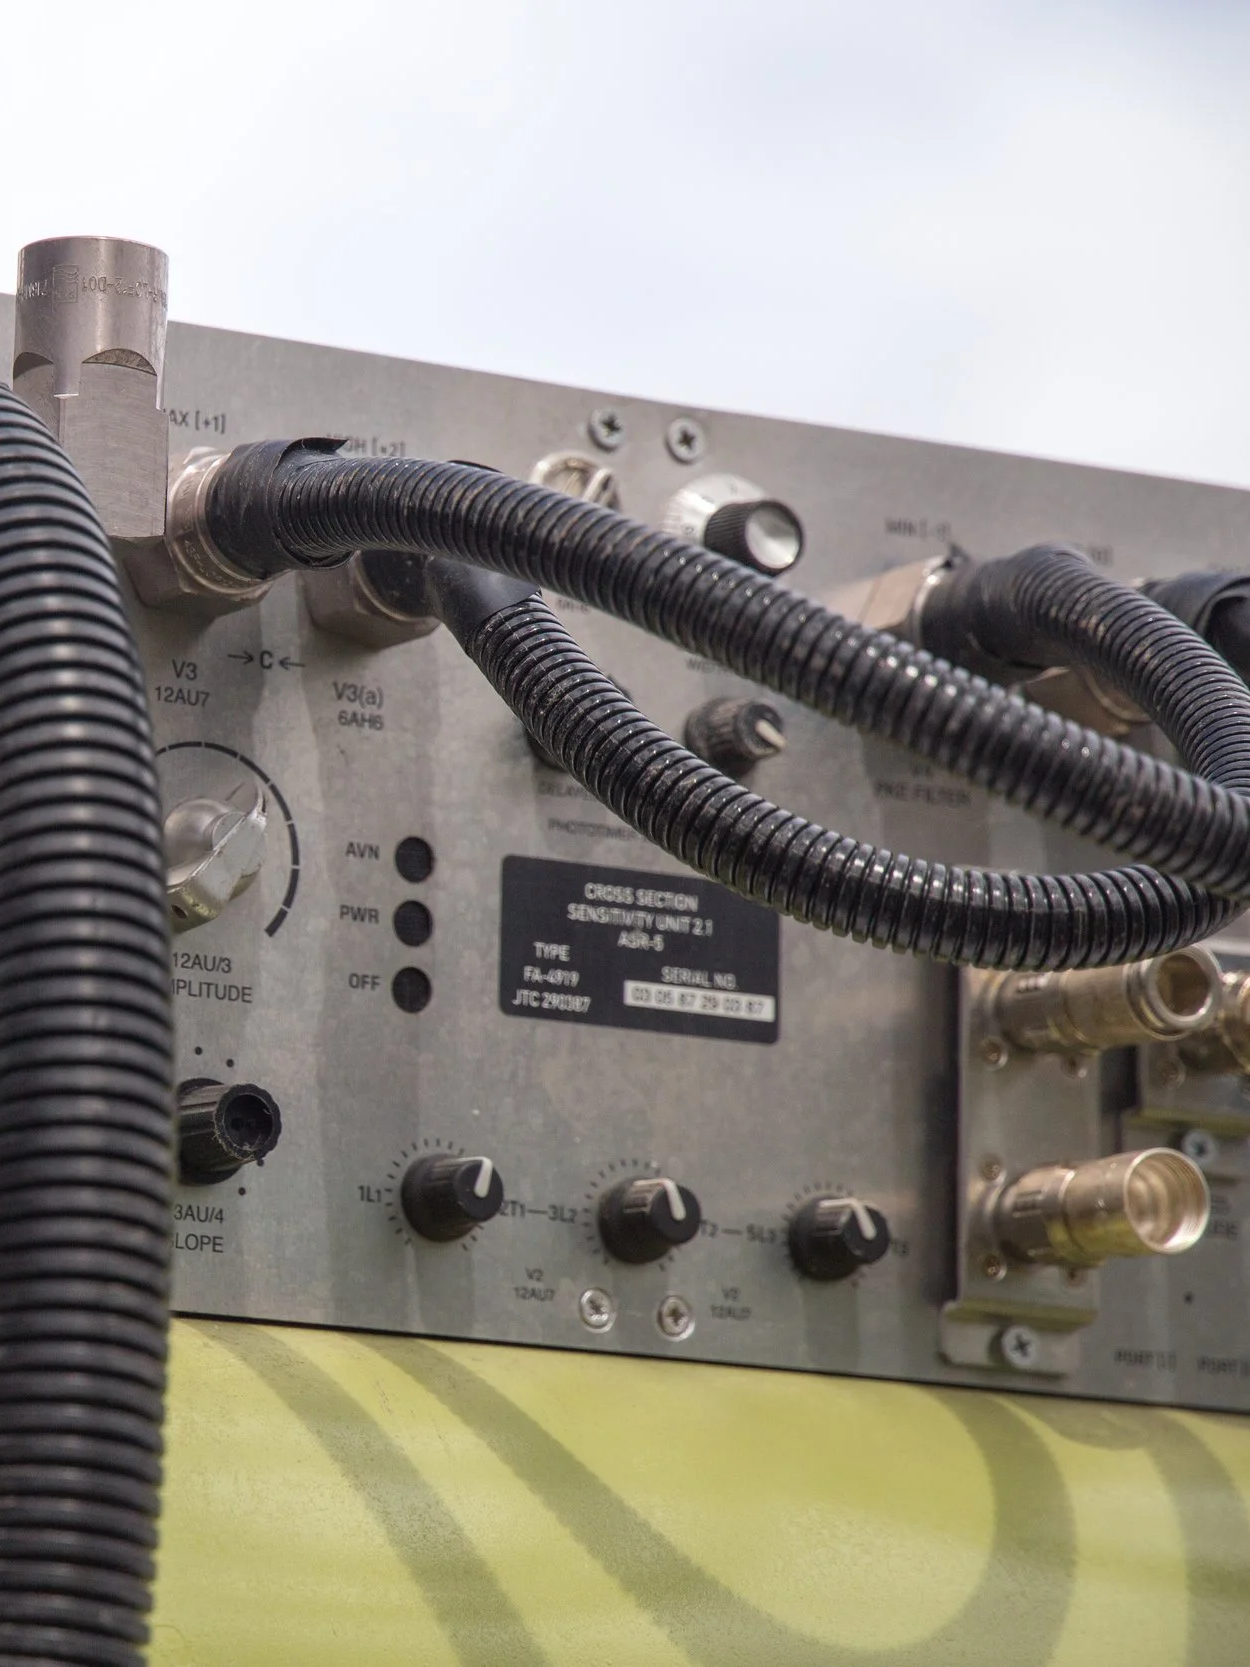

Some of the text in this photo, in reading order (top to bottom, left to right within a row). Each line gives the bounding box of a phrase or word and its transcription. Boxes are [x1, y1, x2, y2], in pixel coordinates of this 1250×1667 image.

[163, 408, 226, 435] AX [+1]
[172, 660, 198, 681] V3
[259, 651, 274, 670] C
[155, 686, 210, 707] 12AU7
[333, 681, 385, 710] V3(a)
[345, 842, 380, 861] AVN
[584, 881, 699, 913] CROSS SECTION
[339, 904, 380, 924] PWR
[567, 902, 655, 929] SENSITIVITY
[655, 914, 691, 934] UNIT
[533, 941, 571, 962] TYPE
[173, 952, 232, 974] 12AU/3
[348, 973, 381, 992] OFF
[661, 965, 713, 988] SERIAL
[171, 978, 253, 1004] PLITUDE
[511, 989, 540, 1008] JTC
[170, 1232, 224, 1253] LOPE
